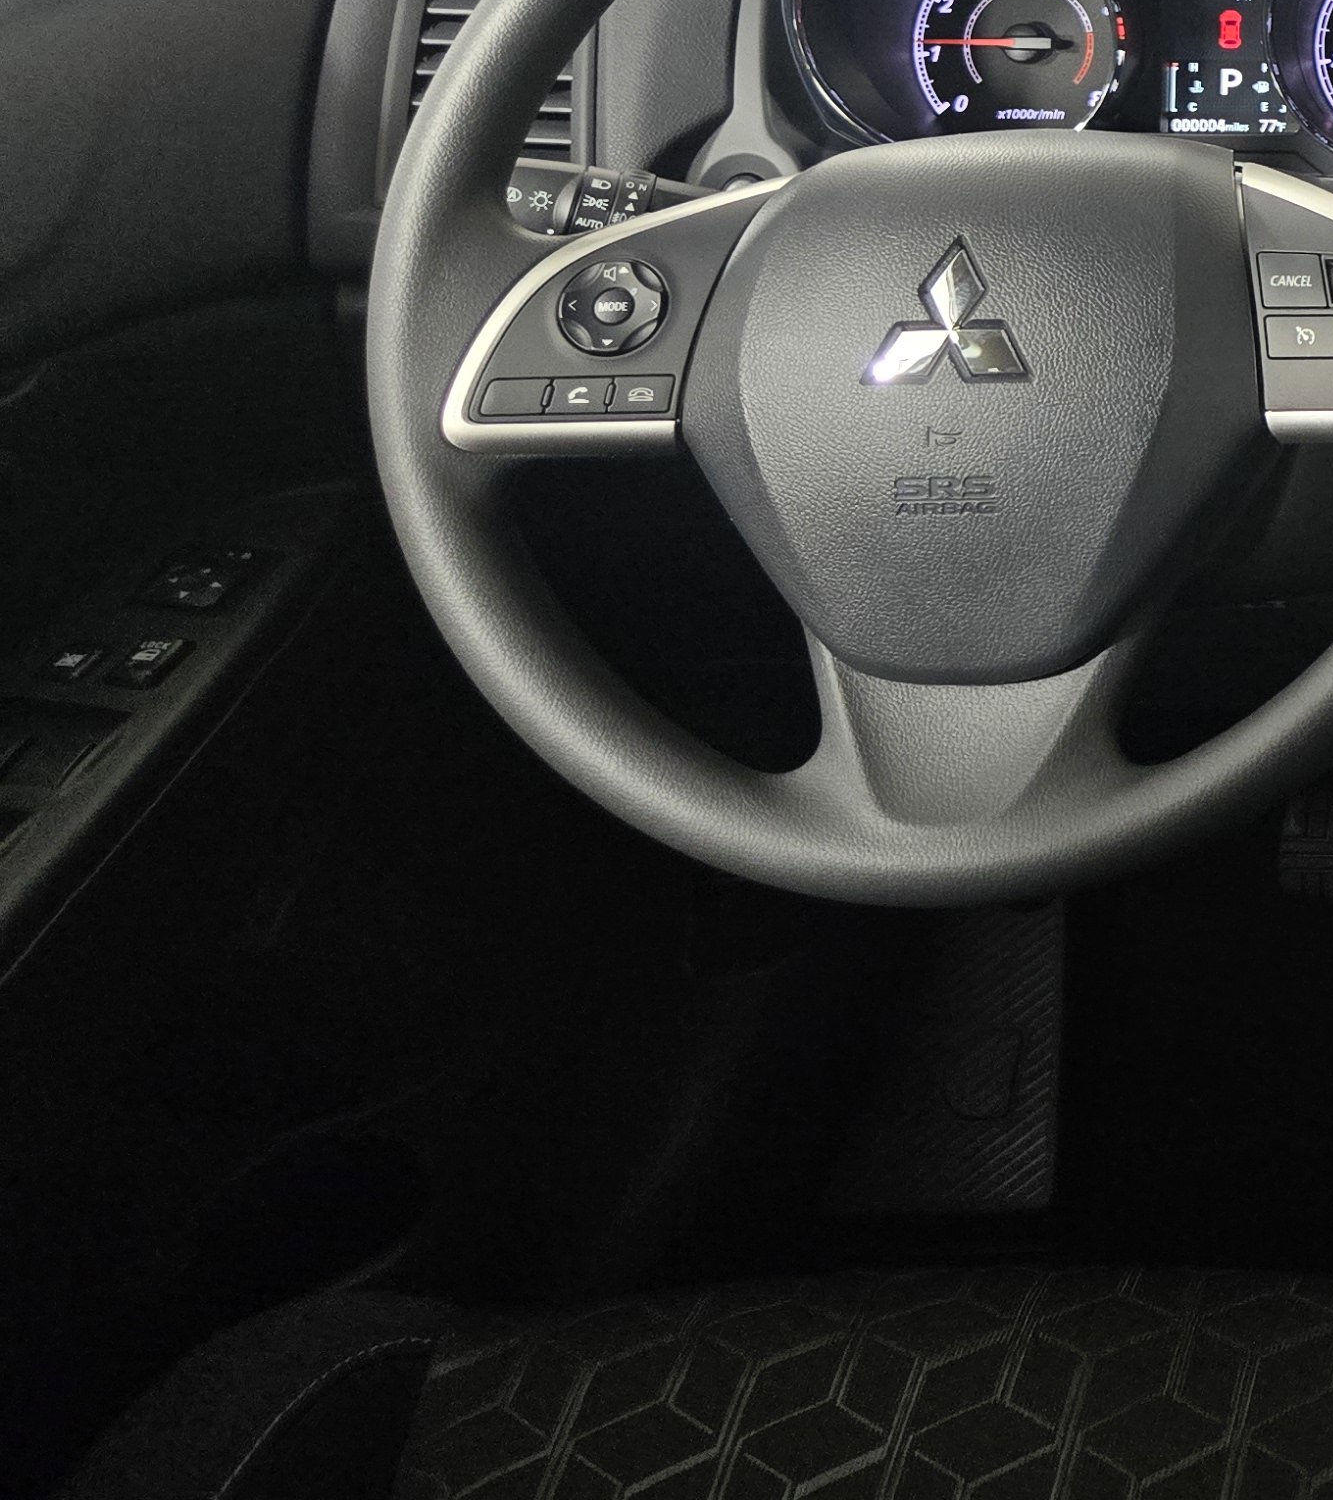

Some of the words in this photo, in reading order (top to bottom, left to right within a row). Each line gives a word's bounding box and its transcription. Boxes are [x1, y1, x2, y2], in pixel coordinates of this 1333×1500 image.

[929, 45, 942, 62] 1
[1219, 68, 1243, 95] P
[953, 95, 969, 112] 0
[1260, 102, 1269, 112] E
[997, 109, 1065, 121] x1000r/min
[1170, 118, 1225, 133] 000004
[575, 216, 604, 231] AUTO
[1270, 275, 1313, 288] CANCEL
[598, 301, 629, 313] MODE
[893, 475, 997, 499] SRS
[894, 499, 999, 515] AIRBAG
